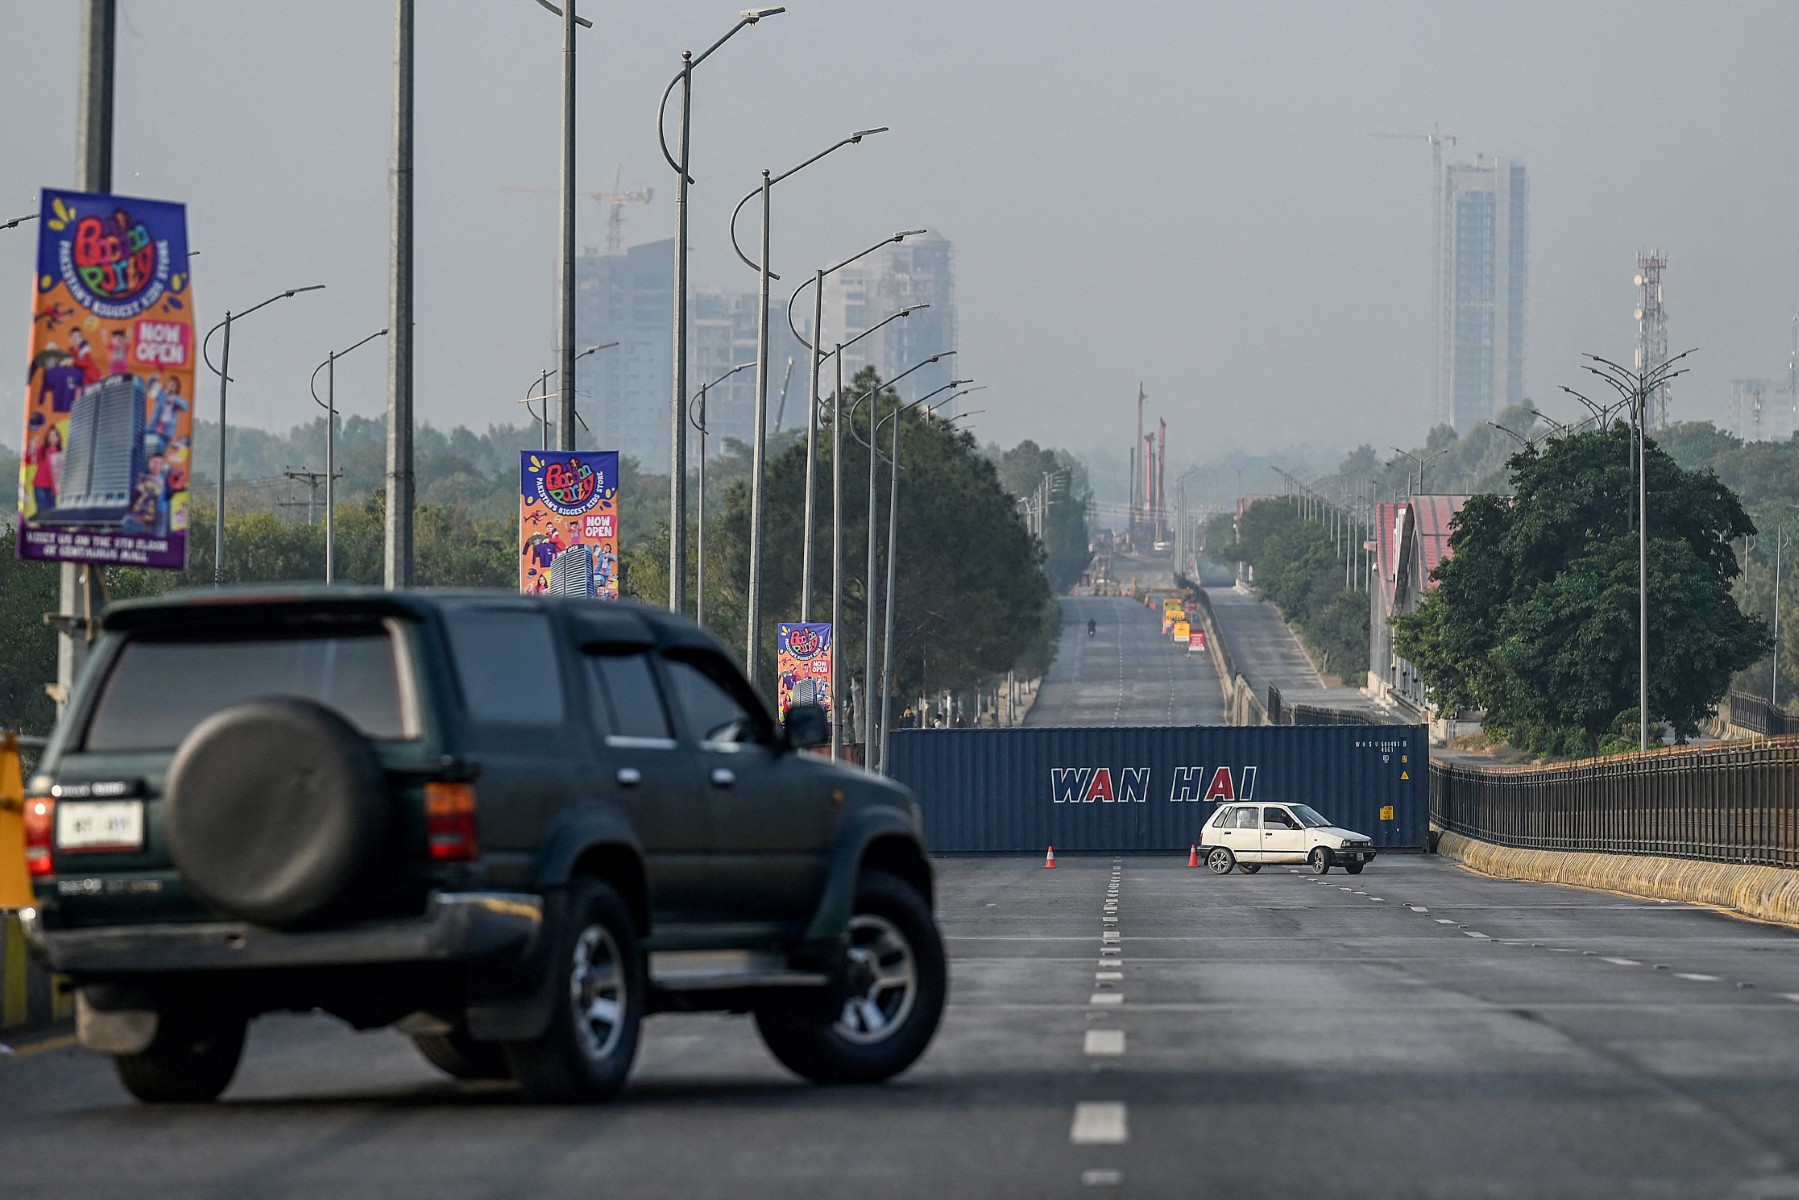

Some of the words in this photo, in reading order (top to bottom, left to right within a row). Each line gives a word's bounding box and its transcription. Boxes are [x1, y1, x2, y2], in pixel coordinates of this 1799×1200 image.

[140, 322, 181, 342] NOW
[136, 342, 184, 363] OPEN
[536, 477, 557, 512] PAKISTAN'S
[558, 507, 587, 516] BIGGEST
[587, 493, 600, 510] KIDS
[597, 471, 605, 493] STORE
[586, 516, 610, 526] NOW
[585, 526, 613, 537] OPEN
[1051, 767, 1151, 803] WAN
[1169, 766, 1257, 802] HAI
